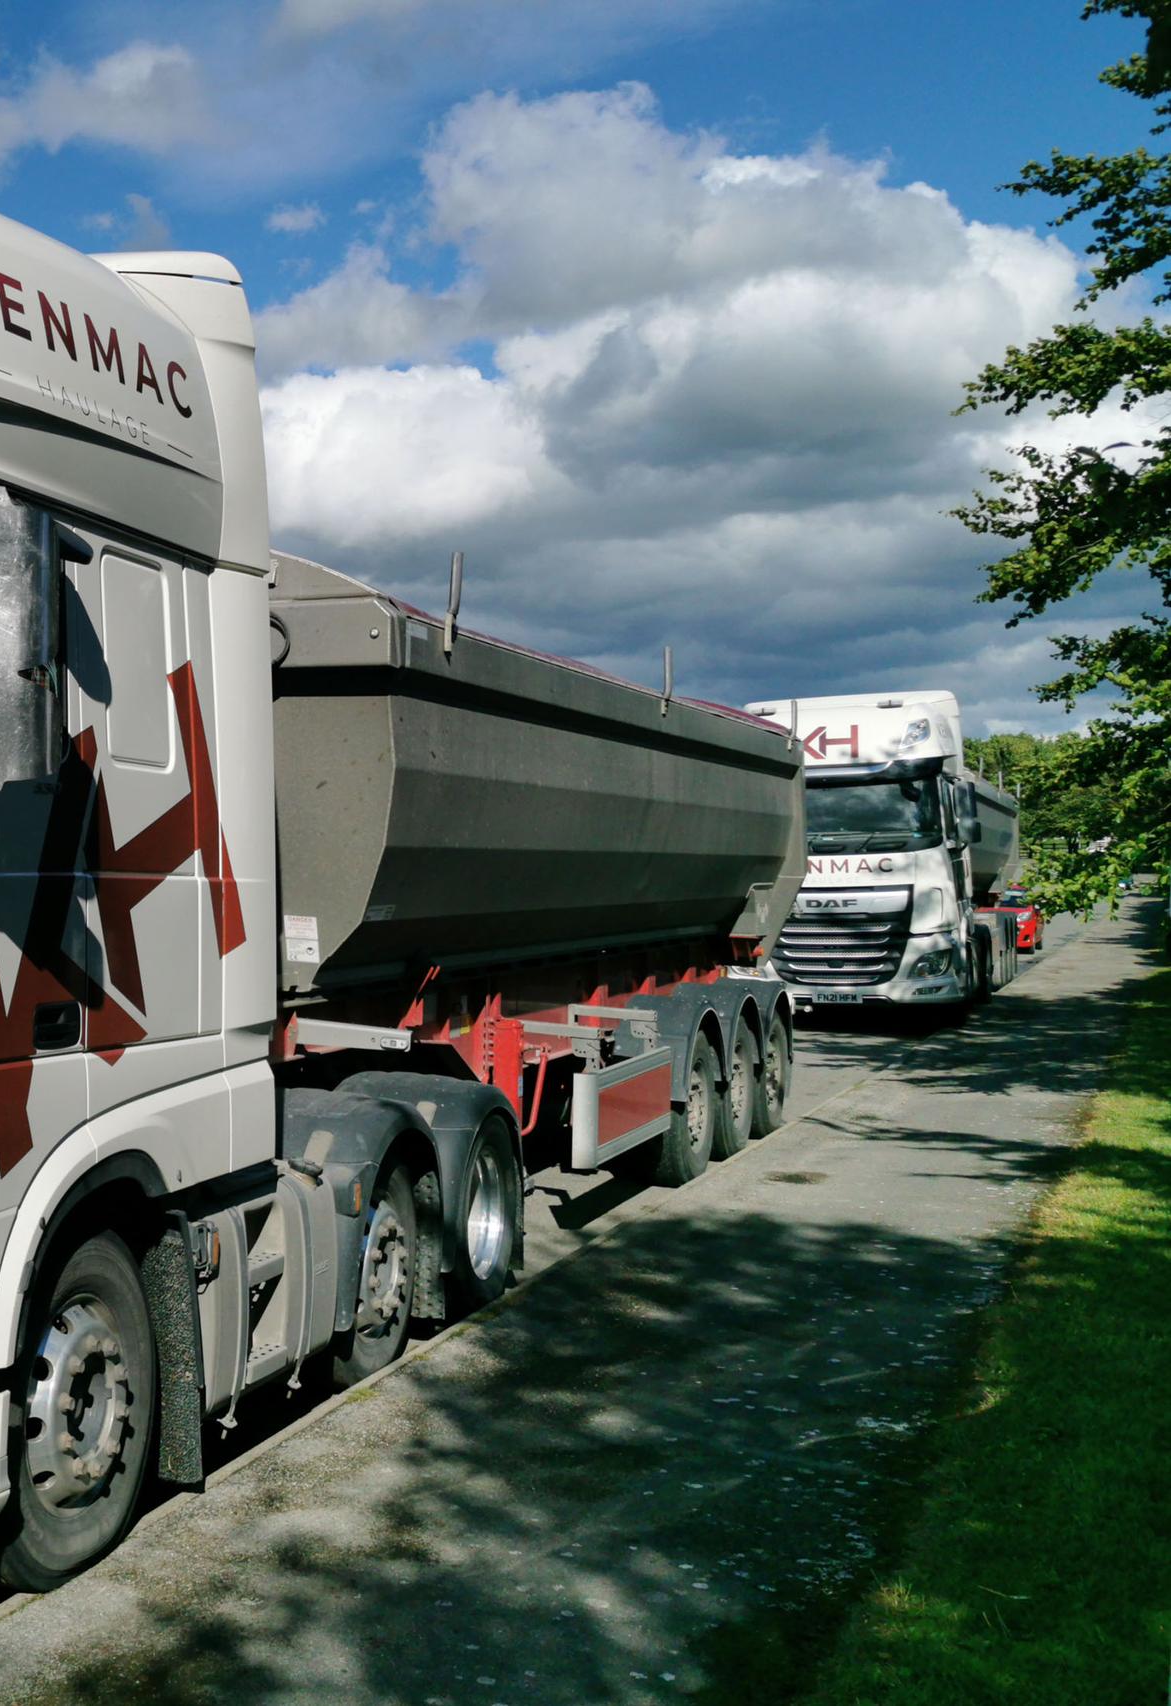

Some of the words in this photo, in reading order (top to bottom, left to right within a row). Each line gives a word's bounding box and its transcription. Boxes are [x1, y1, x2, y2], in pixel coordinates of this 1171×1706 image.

[36, 375, 151, 446] HAULAGE
[807, 858, 893, 874] NMAC
[806, 899, 858, 908] DAF
[817, 993, 837, 1002] FN21
